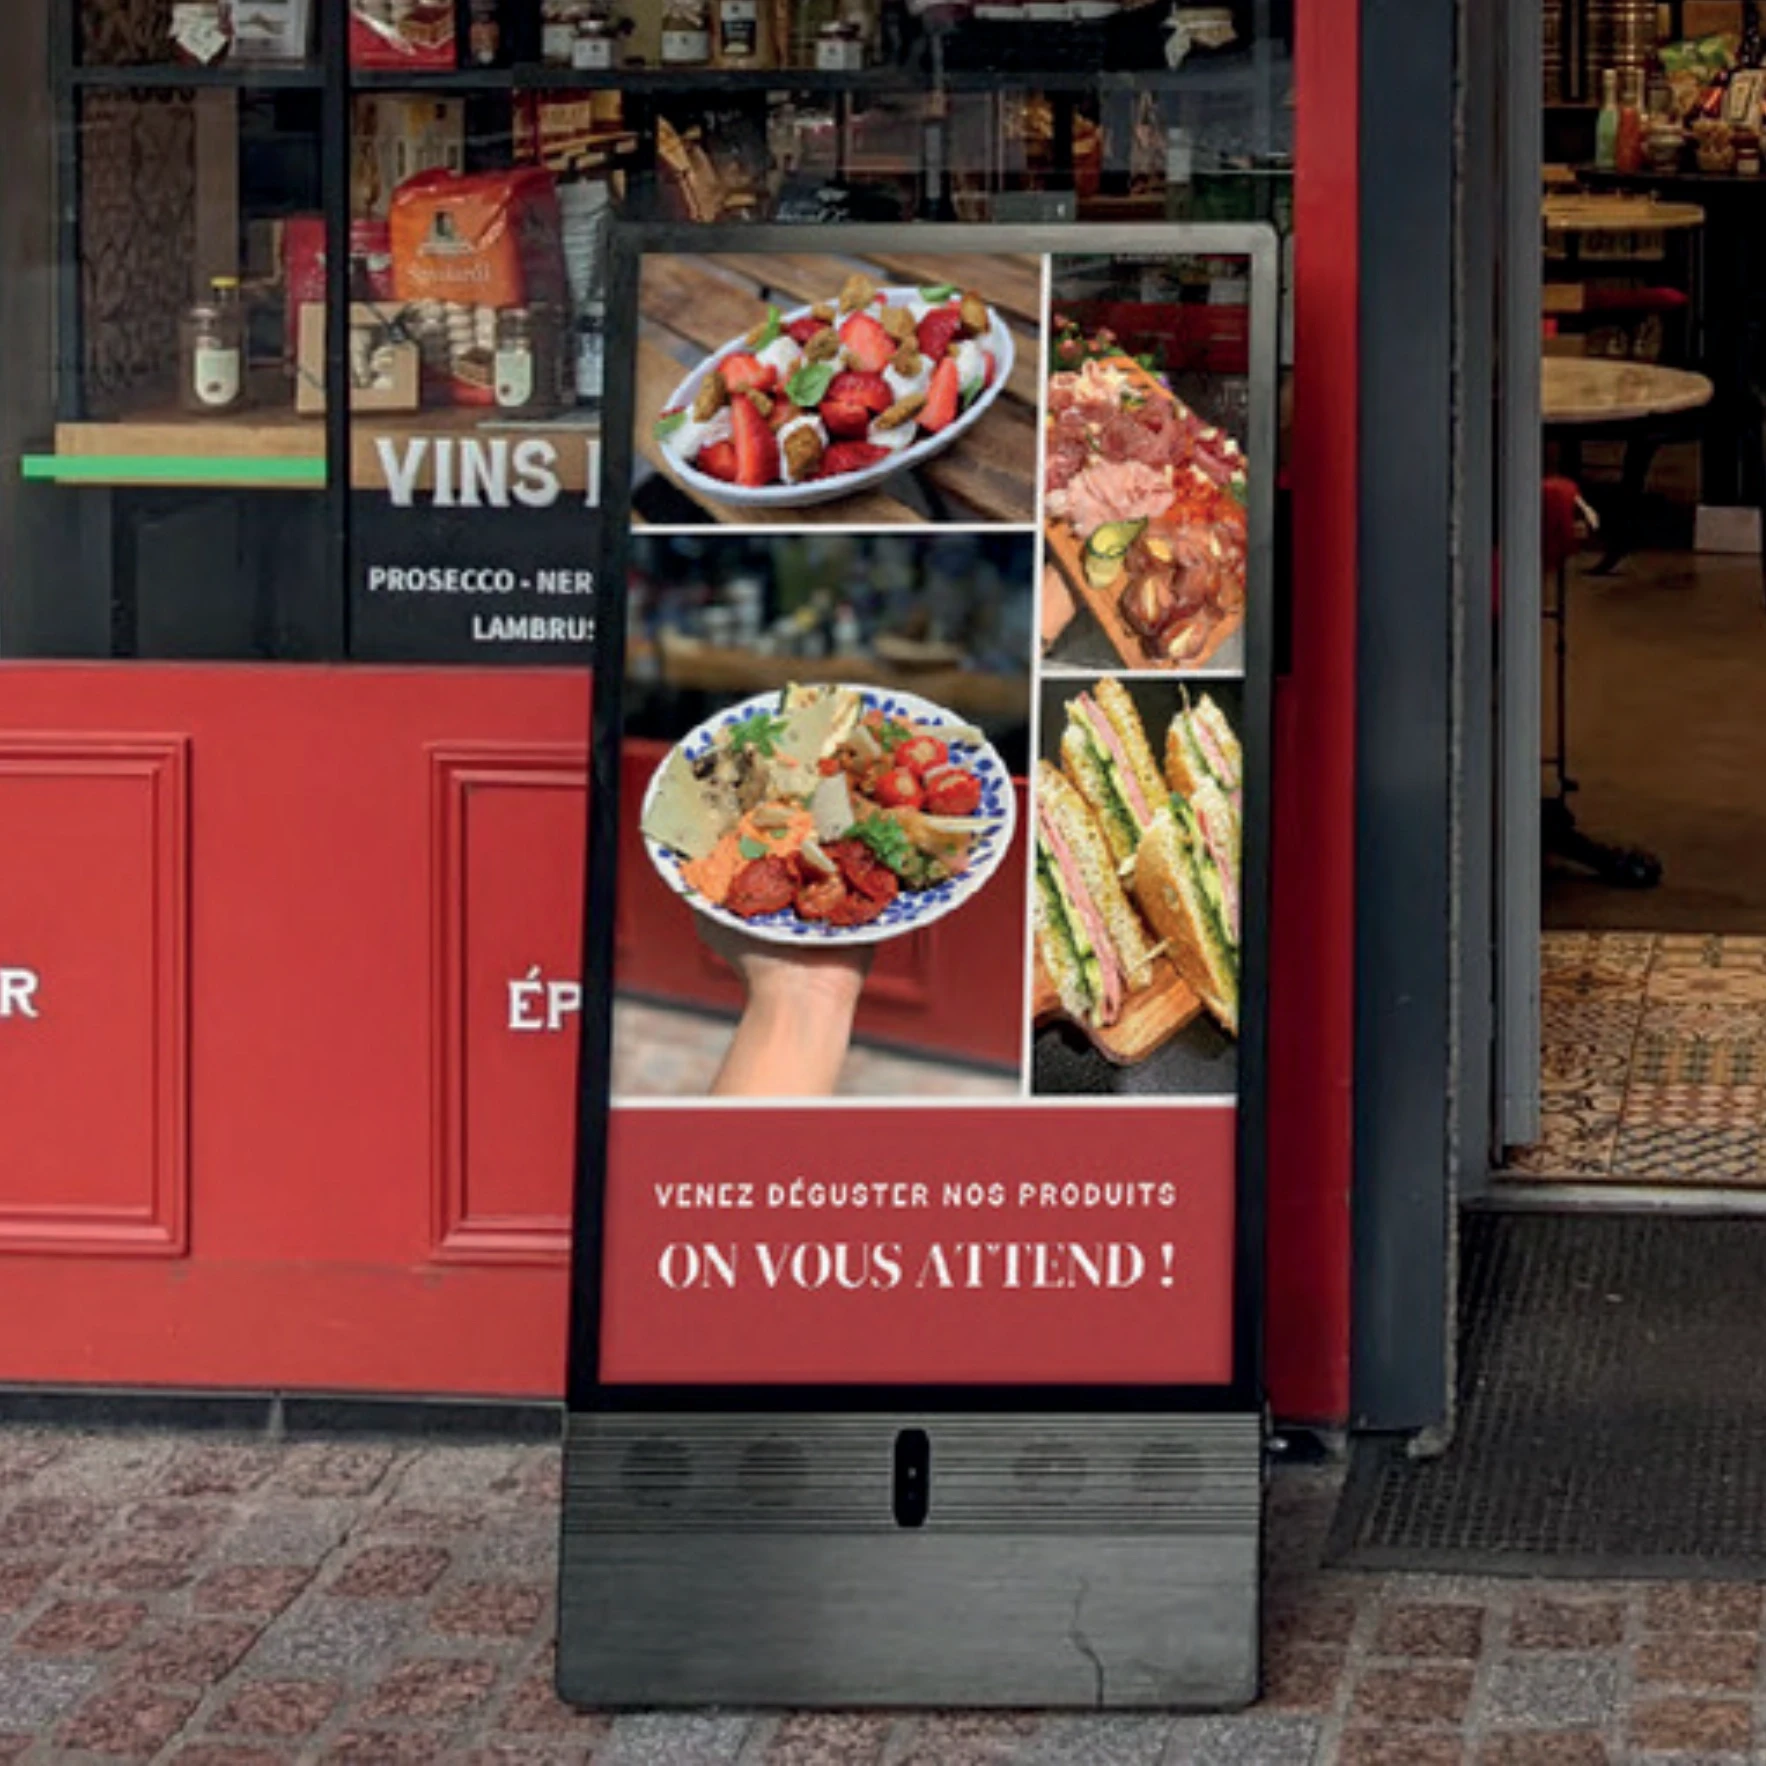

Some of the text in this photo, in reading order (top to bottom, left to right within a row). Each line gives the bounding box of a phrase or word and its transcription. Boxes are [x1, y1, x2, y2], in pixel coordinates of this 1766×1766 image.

[375, 436, 560, 508] VINS
[368, 566, 515, 592] PROSECCO
[536, 570, 594, 595] NER
[0, 967, 39, 1018] R
[507, 965, 582, 1031] ÉP
[654, 1176, 1177, 1209] VENEZ DÉGUSTER NOS PRODUITS
[657, 1242, 1175, 1289] ON VOUS ATTEND !
